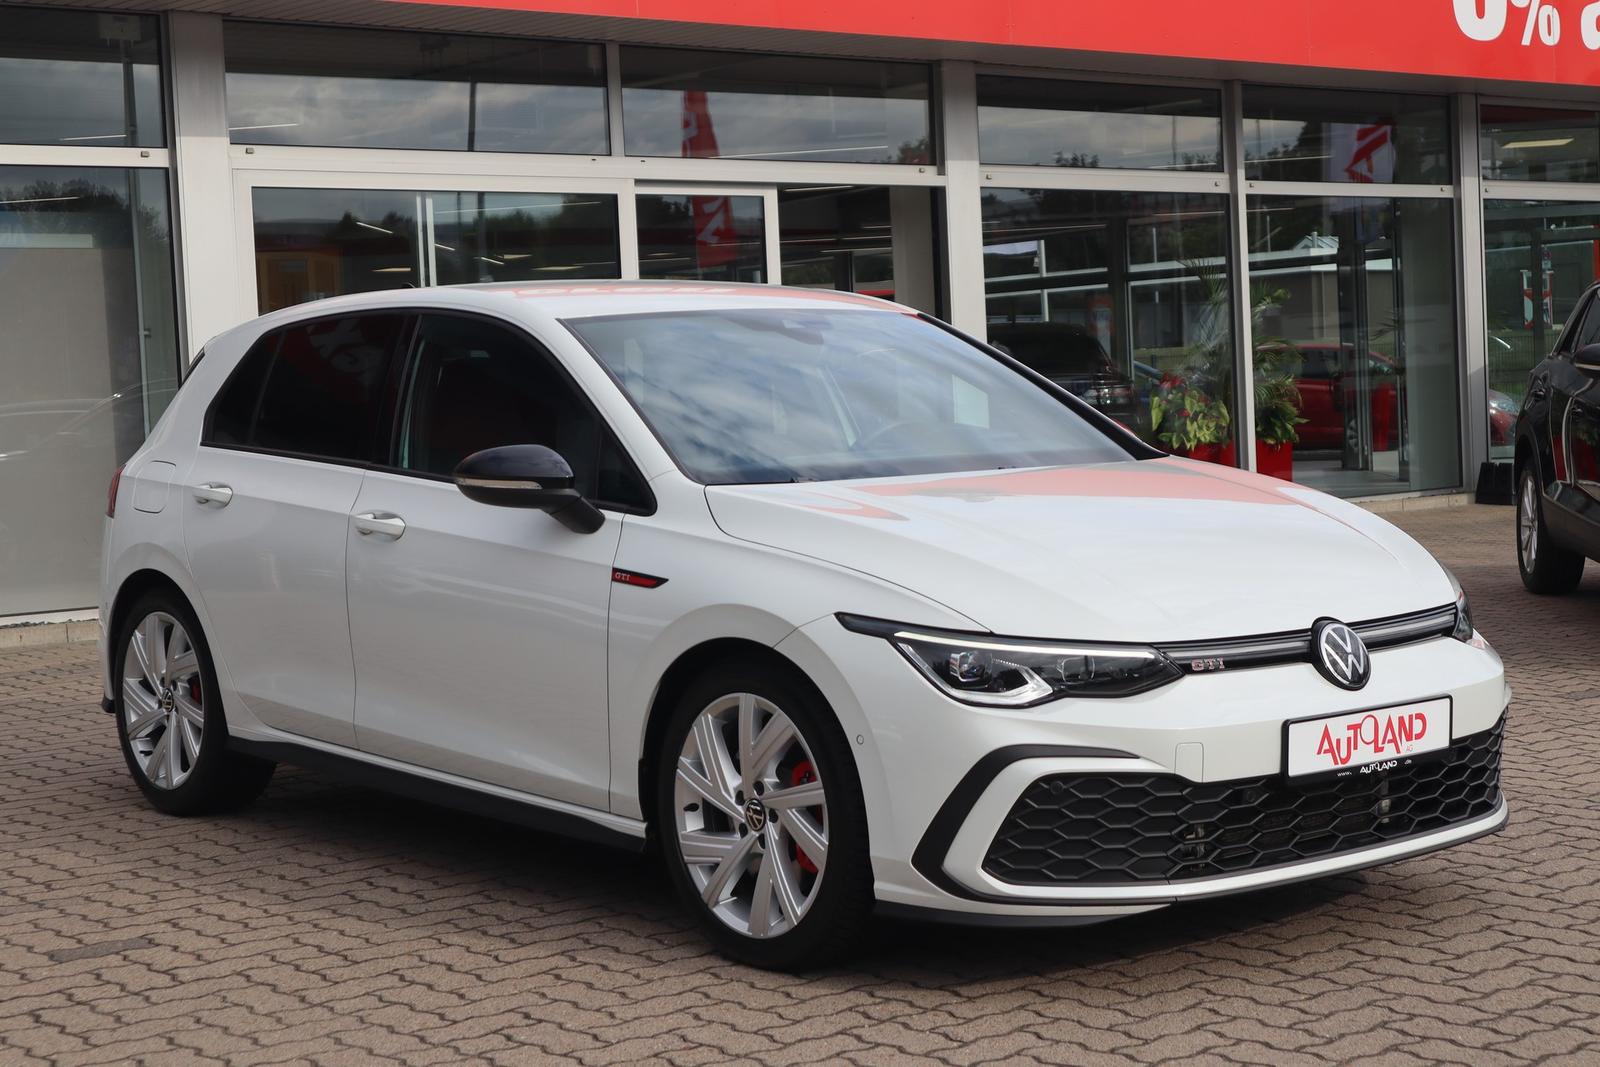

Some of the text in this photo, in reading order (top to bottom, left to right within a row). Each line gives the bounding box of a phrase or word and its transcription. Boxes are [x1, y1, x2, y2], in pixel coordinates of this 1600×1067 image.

[614, 572, 631, 581] GTI
[1191, 657, 1226, 672] GTI
[1317, 712, 1427, 765] AUTOLAND
